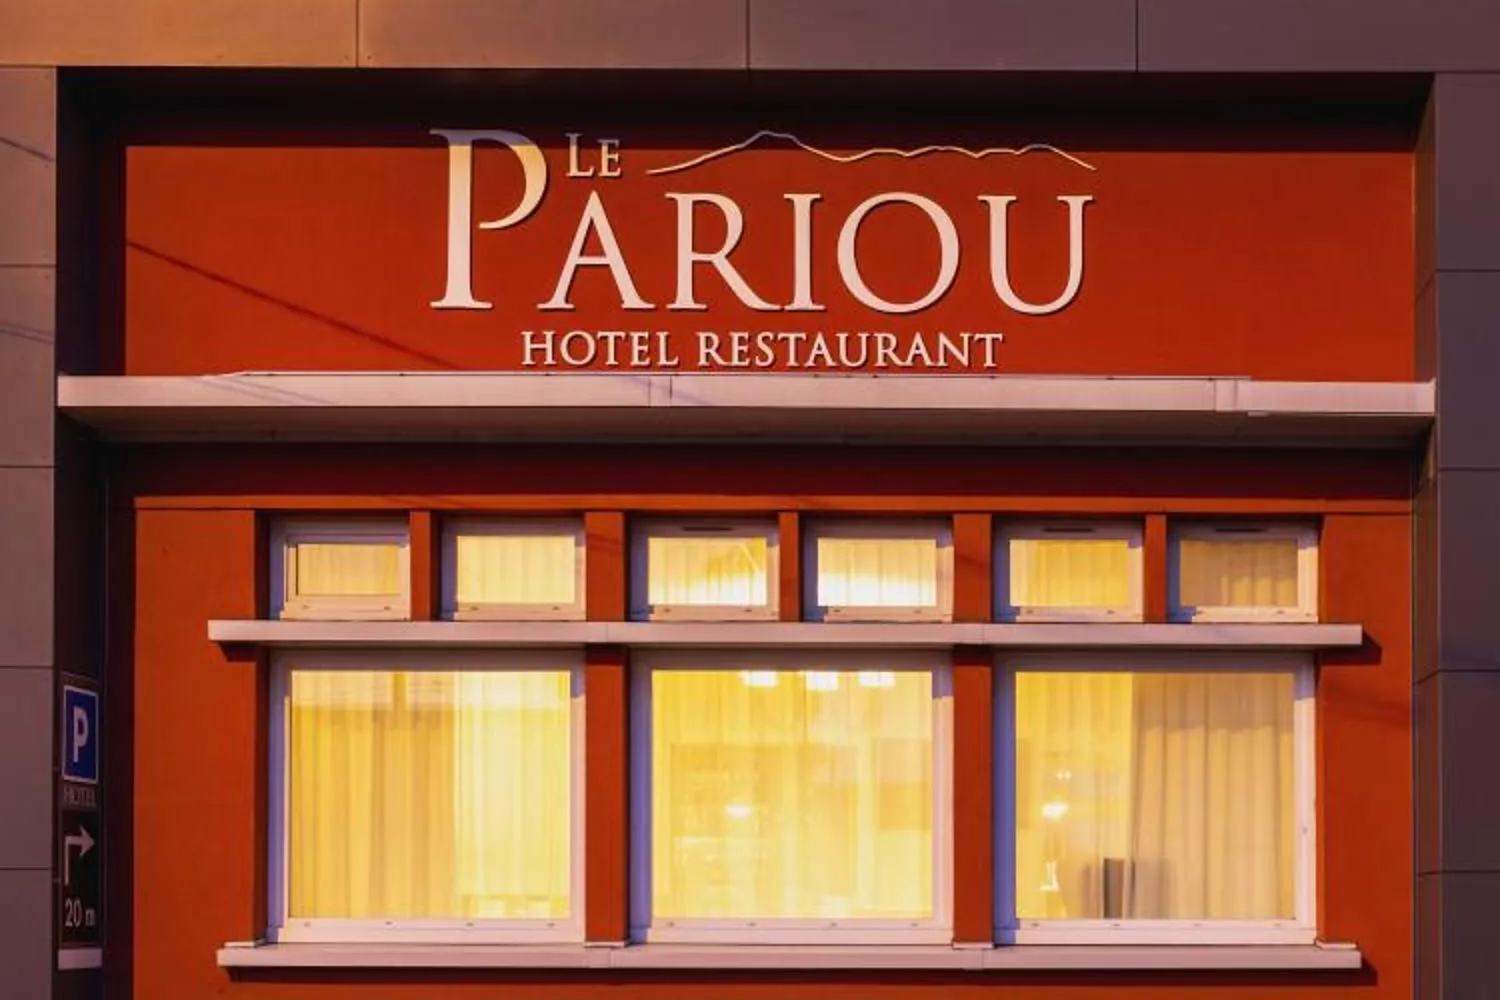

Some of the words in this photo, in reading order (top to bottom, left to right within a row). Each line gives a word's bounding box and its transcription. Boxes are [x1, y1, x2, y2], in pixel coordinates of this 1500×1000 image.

[565, 133, 622, 178] LE
[429, 128, 1094, 315] PARIOU
[520, 331, 679, 368] HOTEL
[696, 332, 1003, 368] RESTAURANT
[73, 706, 89, 762] P
[65, 898, 81, 927] 20
[84, 906, 95, 926] m
